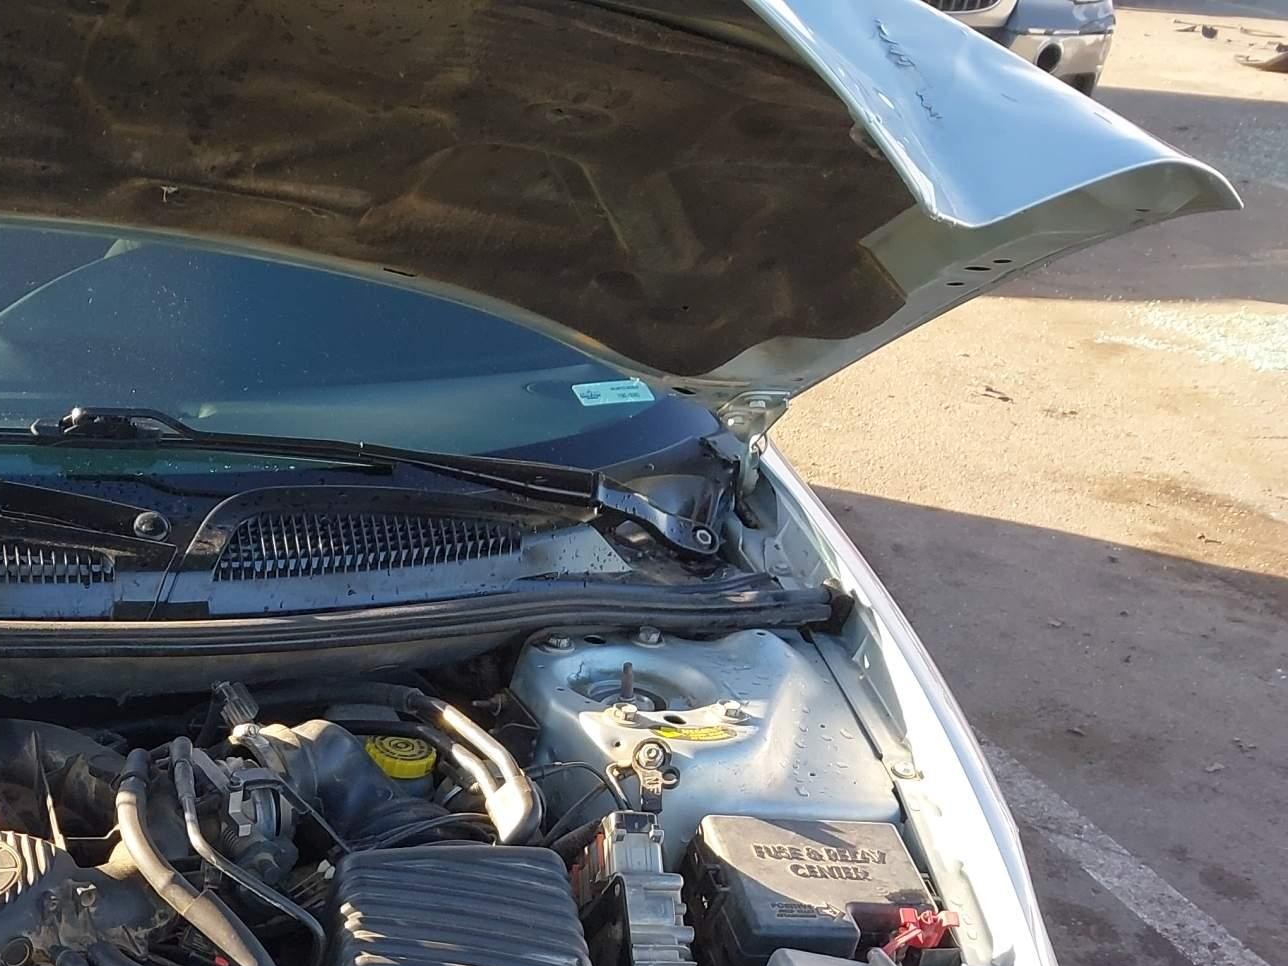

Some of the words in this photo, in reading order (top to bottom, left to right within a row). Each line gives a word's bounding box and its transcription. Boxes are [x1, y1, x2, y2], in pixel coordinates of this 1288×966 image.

[752, 844, 804, 861] FUSE
[823, 847, 887, 865] RELAY
[789, 864, 872, 881] CENTER
